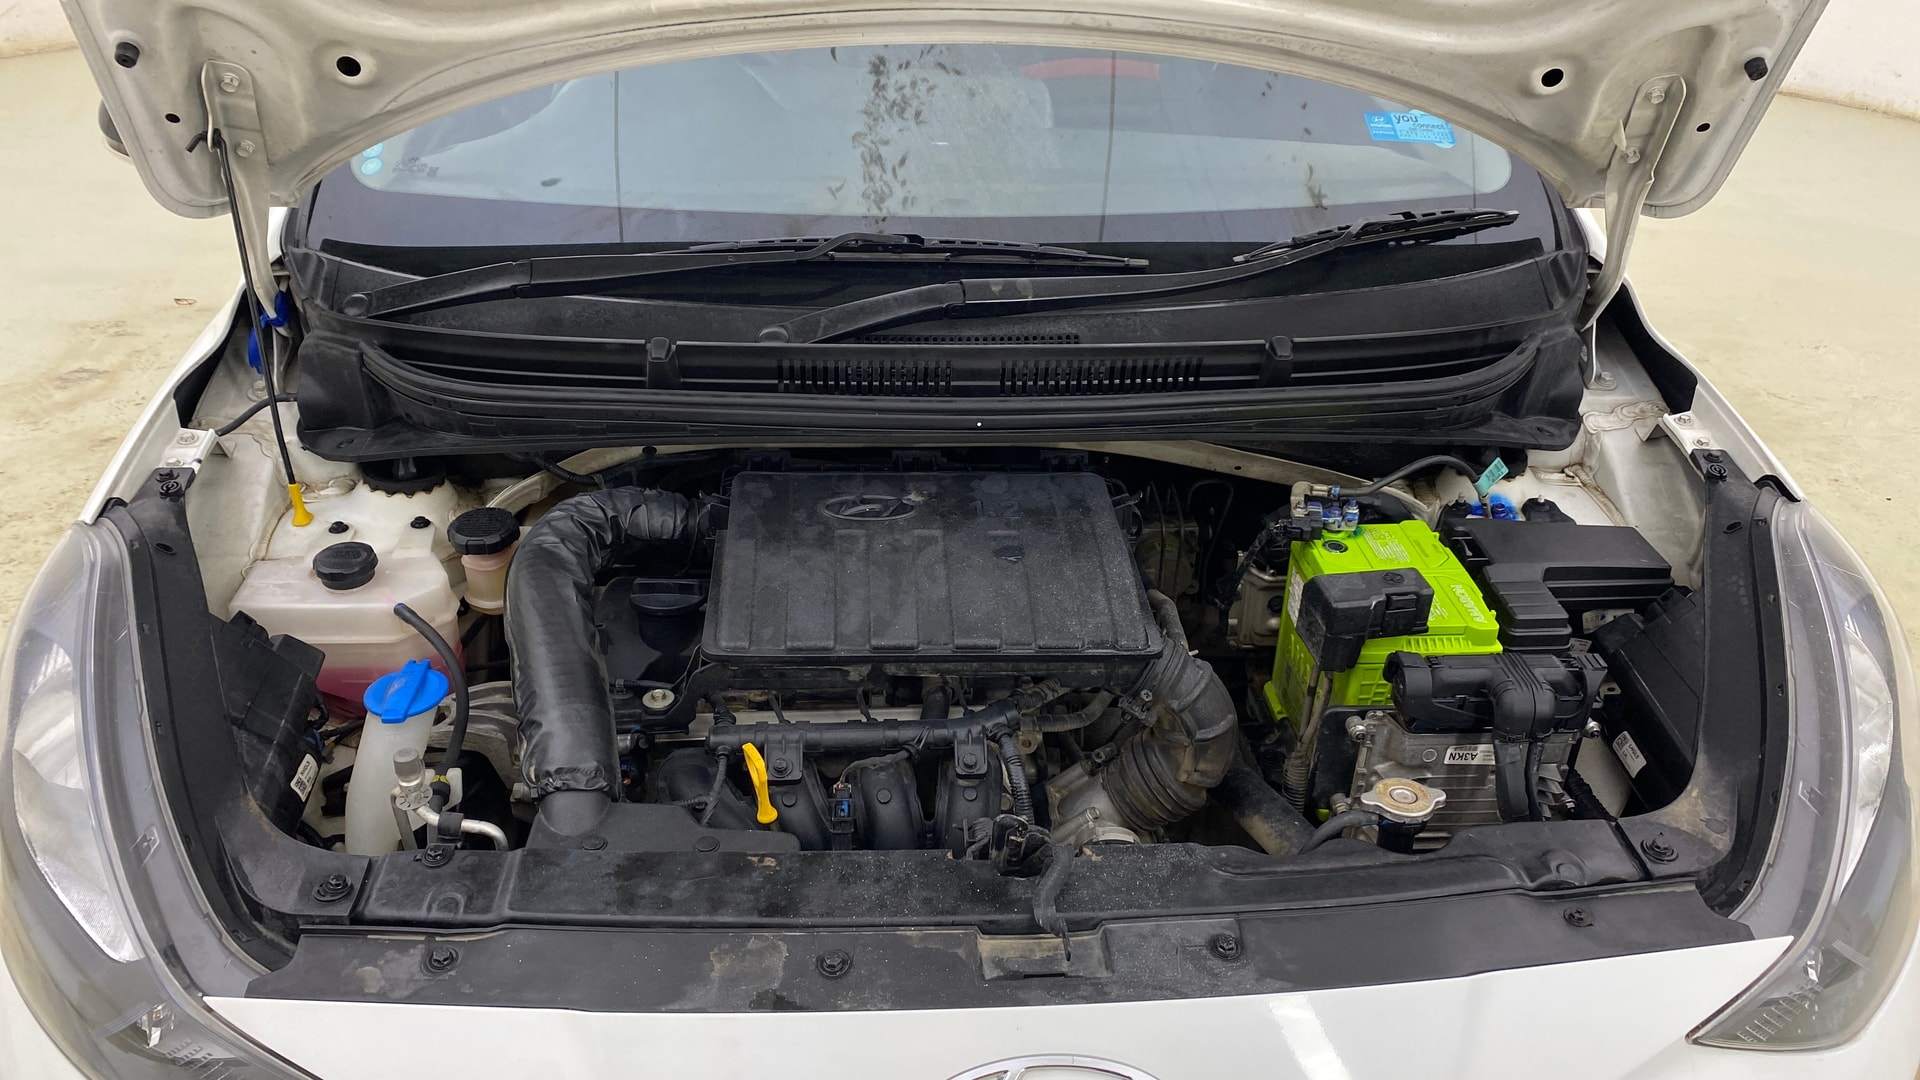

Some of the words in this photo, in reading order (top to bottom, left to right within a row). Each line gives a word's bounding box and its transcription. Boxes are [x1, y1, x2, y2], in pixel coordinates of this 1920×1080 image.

[1394, 114, 1418, 124] you
[1451, 585, 1487, 623] AMARON
[1448, 752, 1478, 761] A3KN
